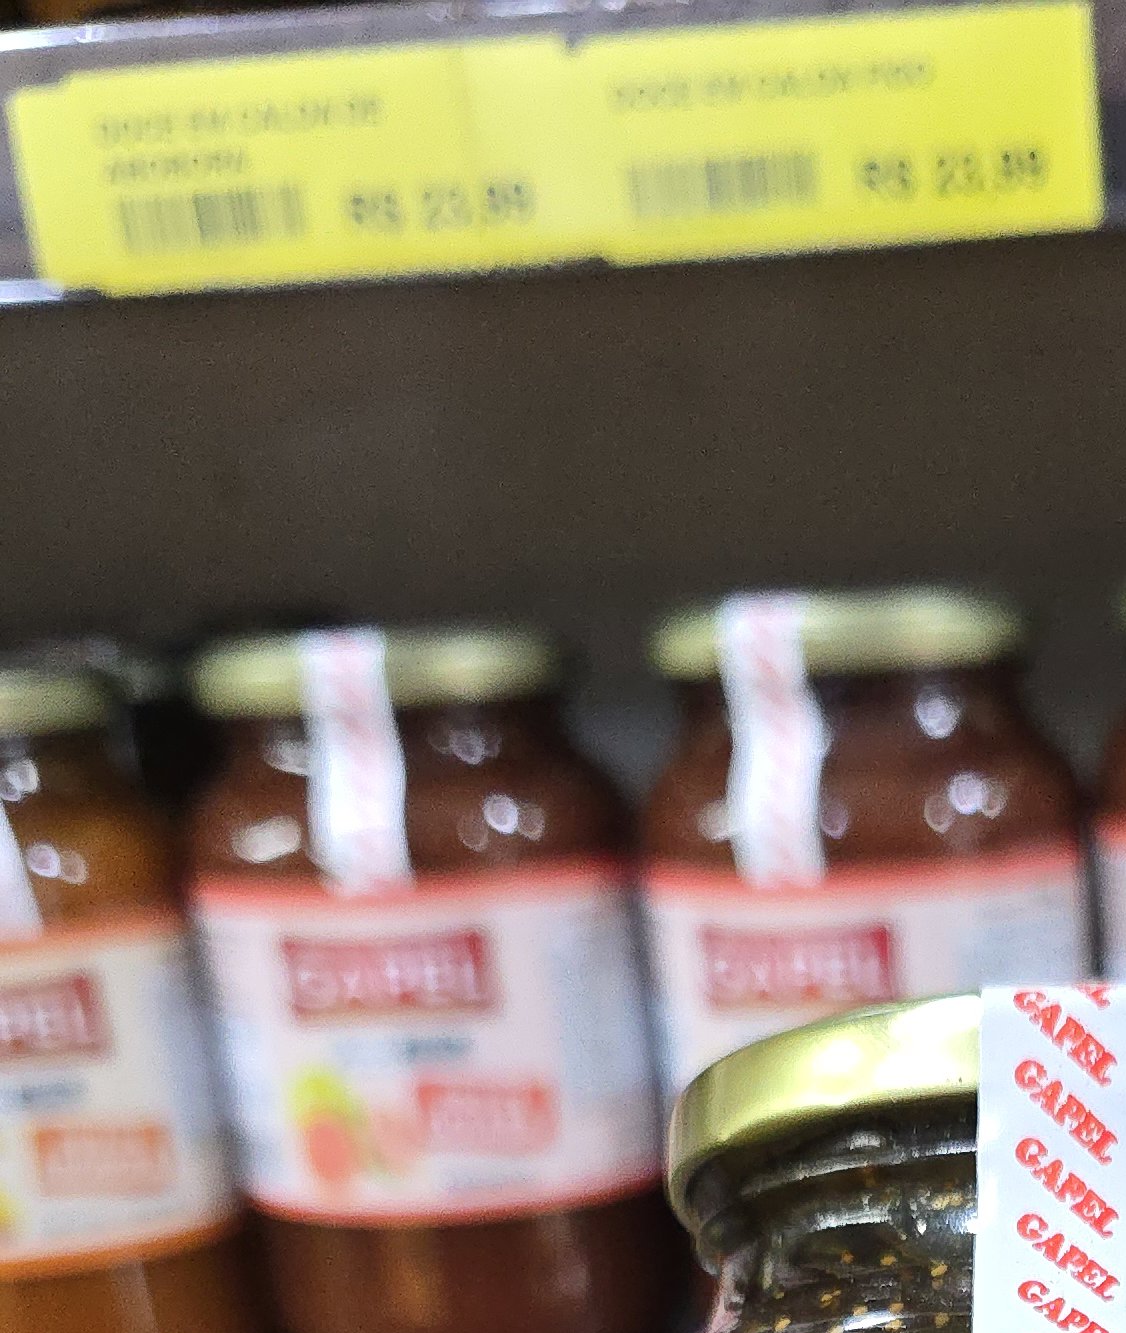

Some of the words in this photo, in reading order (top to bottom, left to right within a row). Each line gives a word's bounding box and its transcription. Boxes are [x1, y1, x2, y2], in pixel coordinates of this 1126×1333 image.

[1013, 991, 1118, 1087] GAPEL
[1014, 1059, 1119, 1166] GAPEL
[1015, 1137, 1119, 1240] GAPEL
[1016, 1213, 1121, 1302] GAPEL
